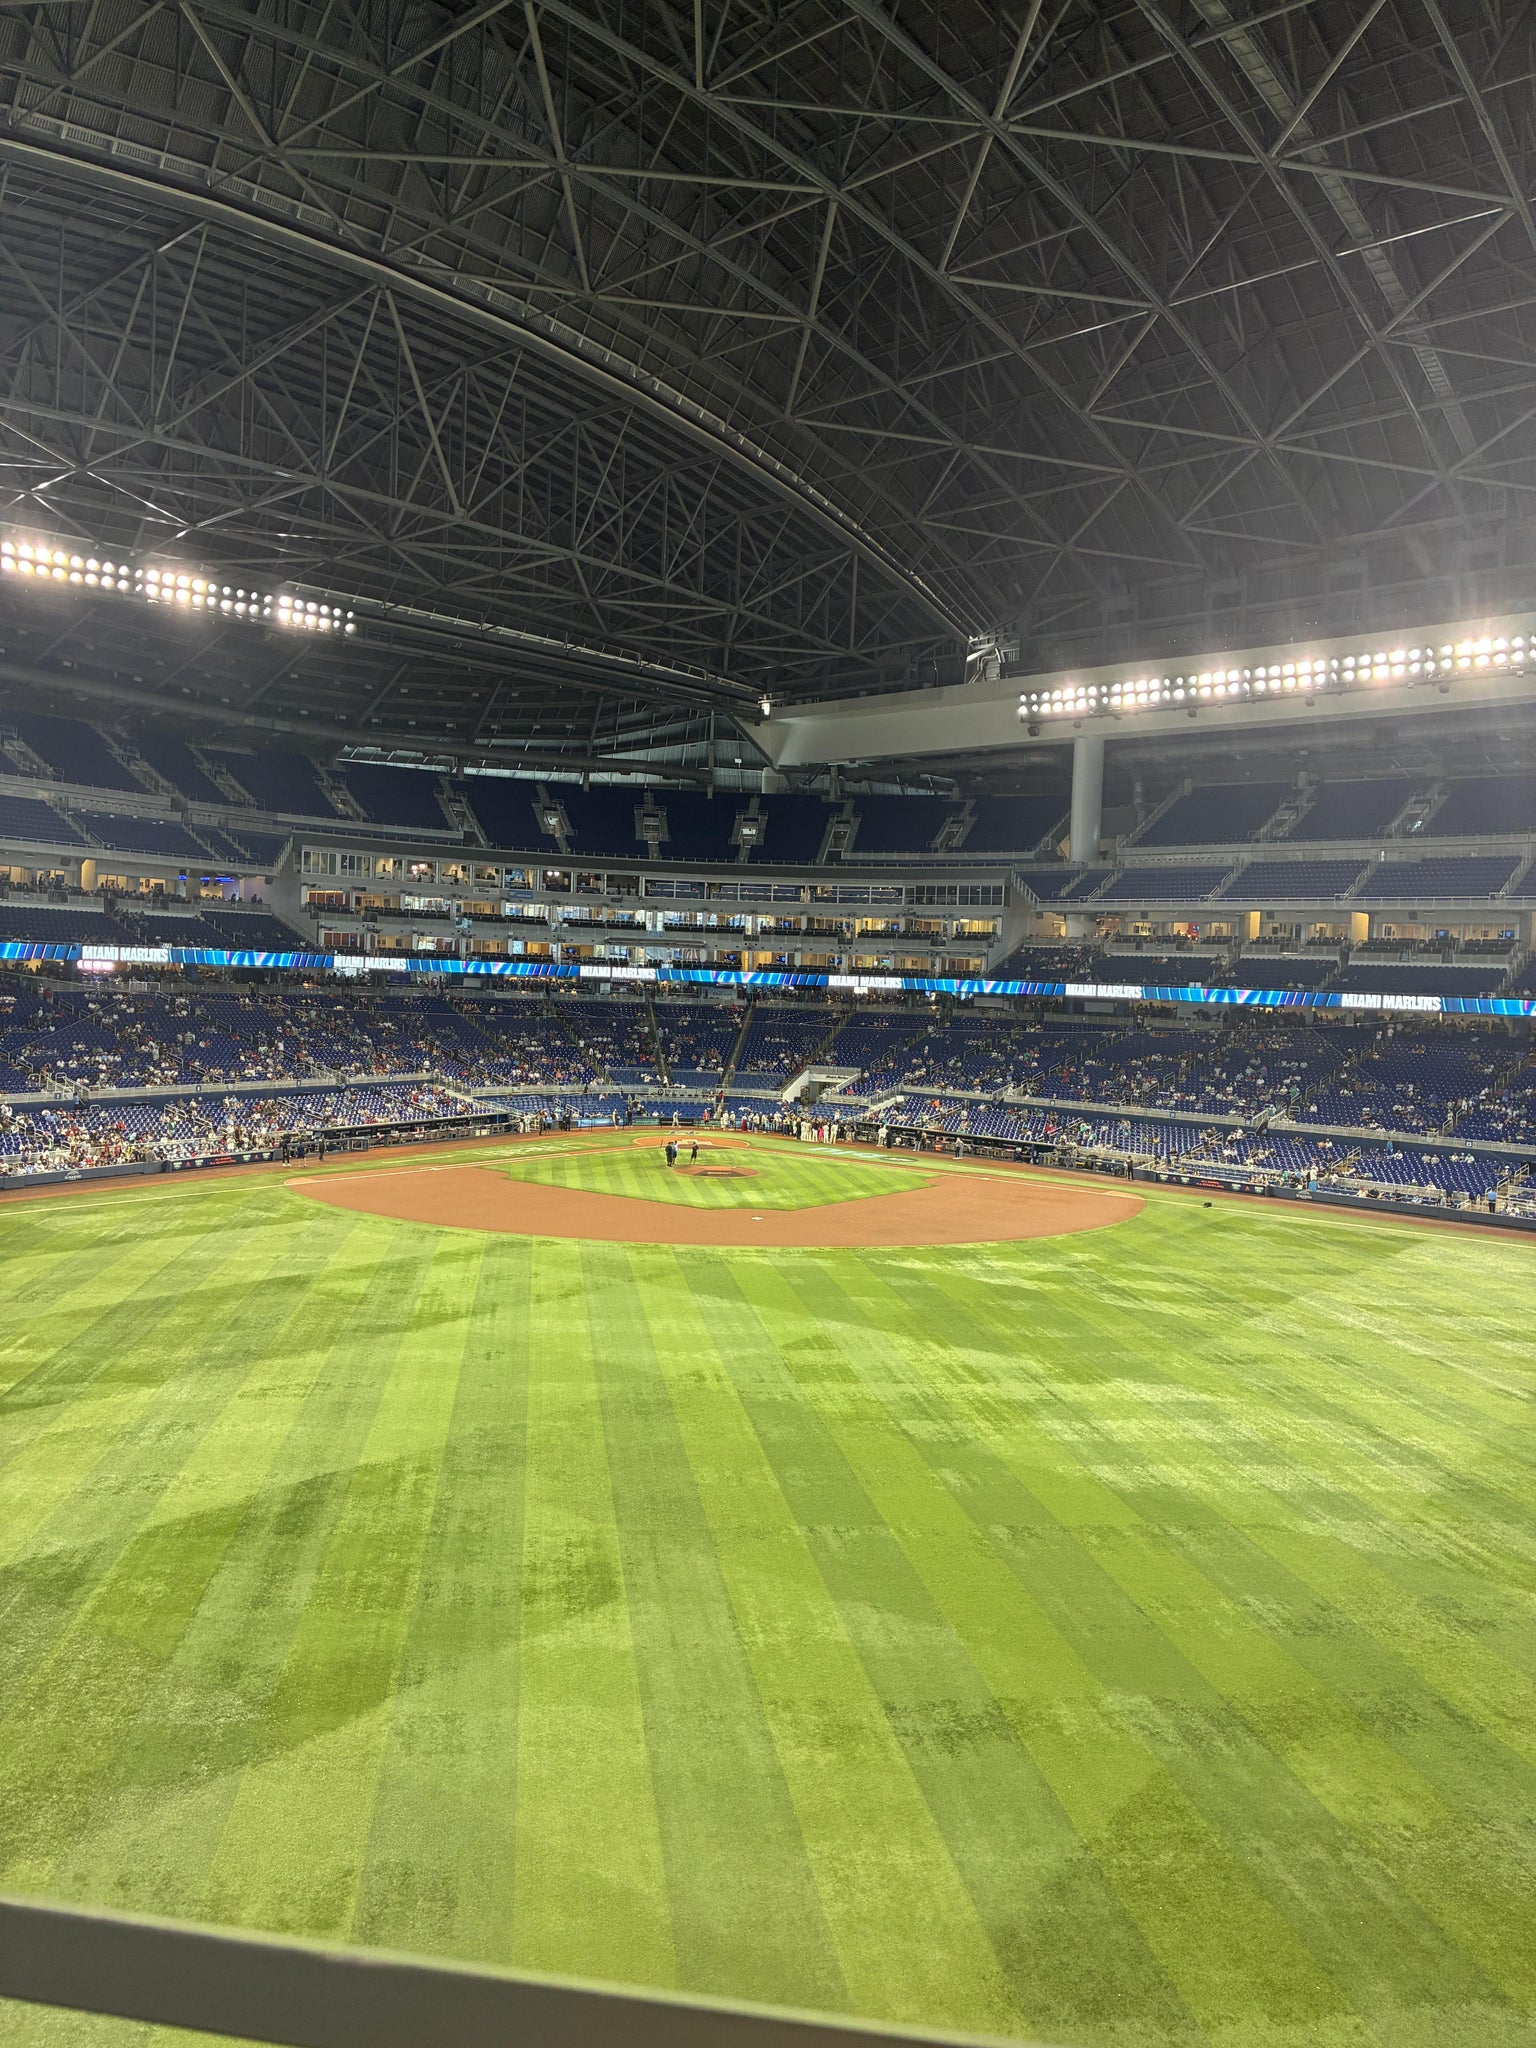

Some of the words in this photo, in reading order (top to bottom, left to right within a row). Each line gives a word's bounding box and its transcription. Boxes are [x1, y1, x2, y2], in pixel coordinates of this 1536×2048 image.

[82, 945, 119, 960] MIAMI
[119, 947, 169, 963] MARLINS
[333, 956, 364, 968] MIAMI
[365, 957, 407, 970] MARLINS
[580, 966, 611, 977] MIAMI
[612, 967, 656, 979] MARLINS
[828, 975, 859, 986] MIAMI
[860, 976, 903, 988] MARLINS
[1065, 984, 1097, 996] MIAMI
[1098, 985, 1142, 998] MARLINS
[1341, 993, 1381, 1007] MIAMI
[1383, 995, 1441, 1010] MARLINS
